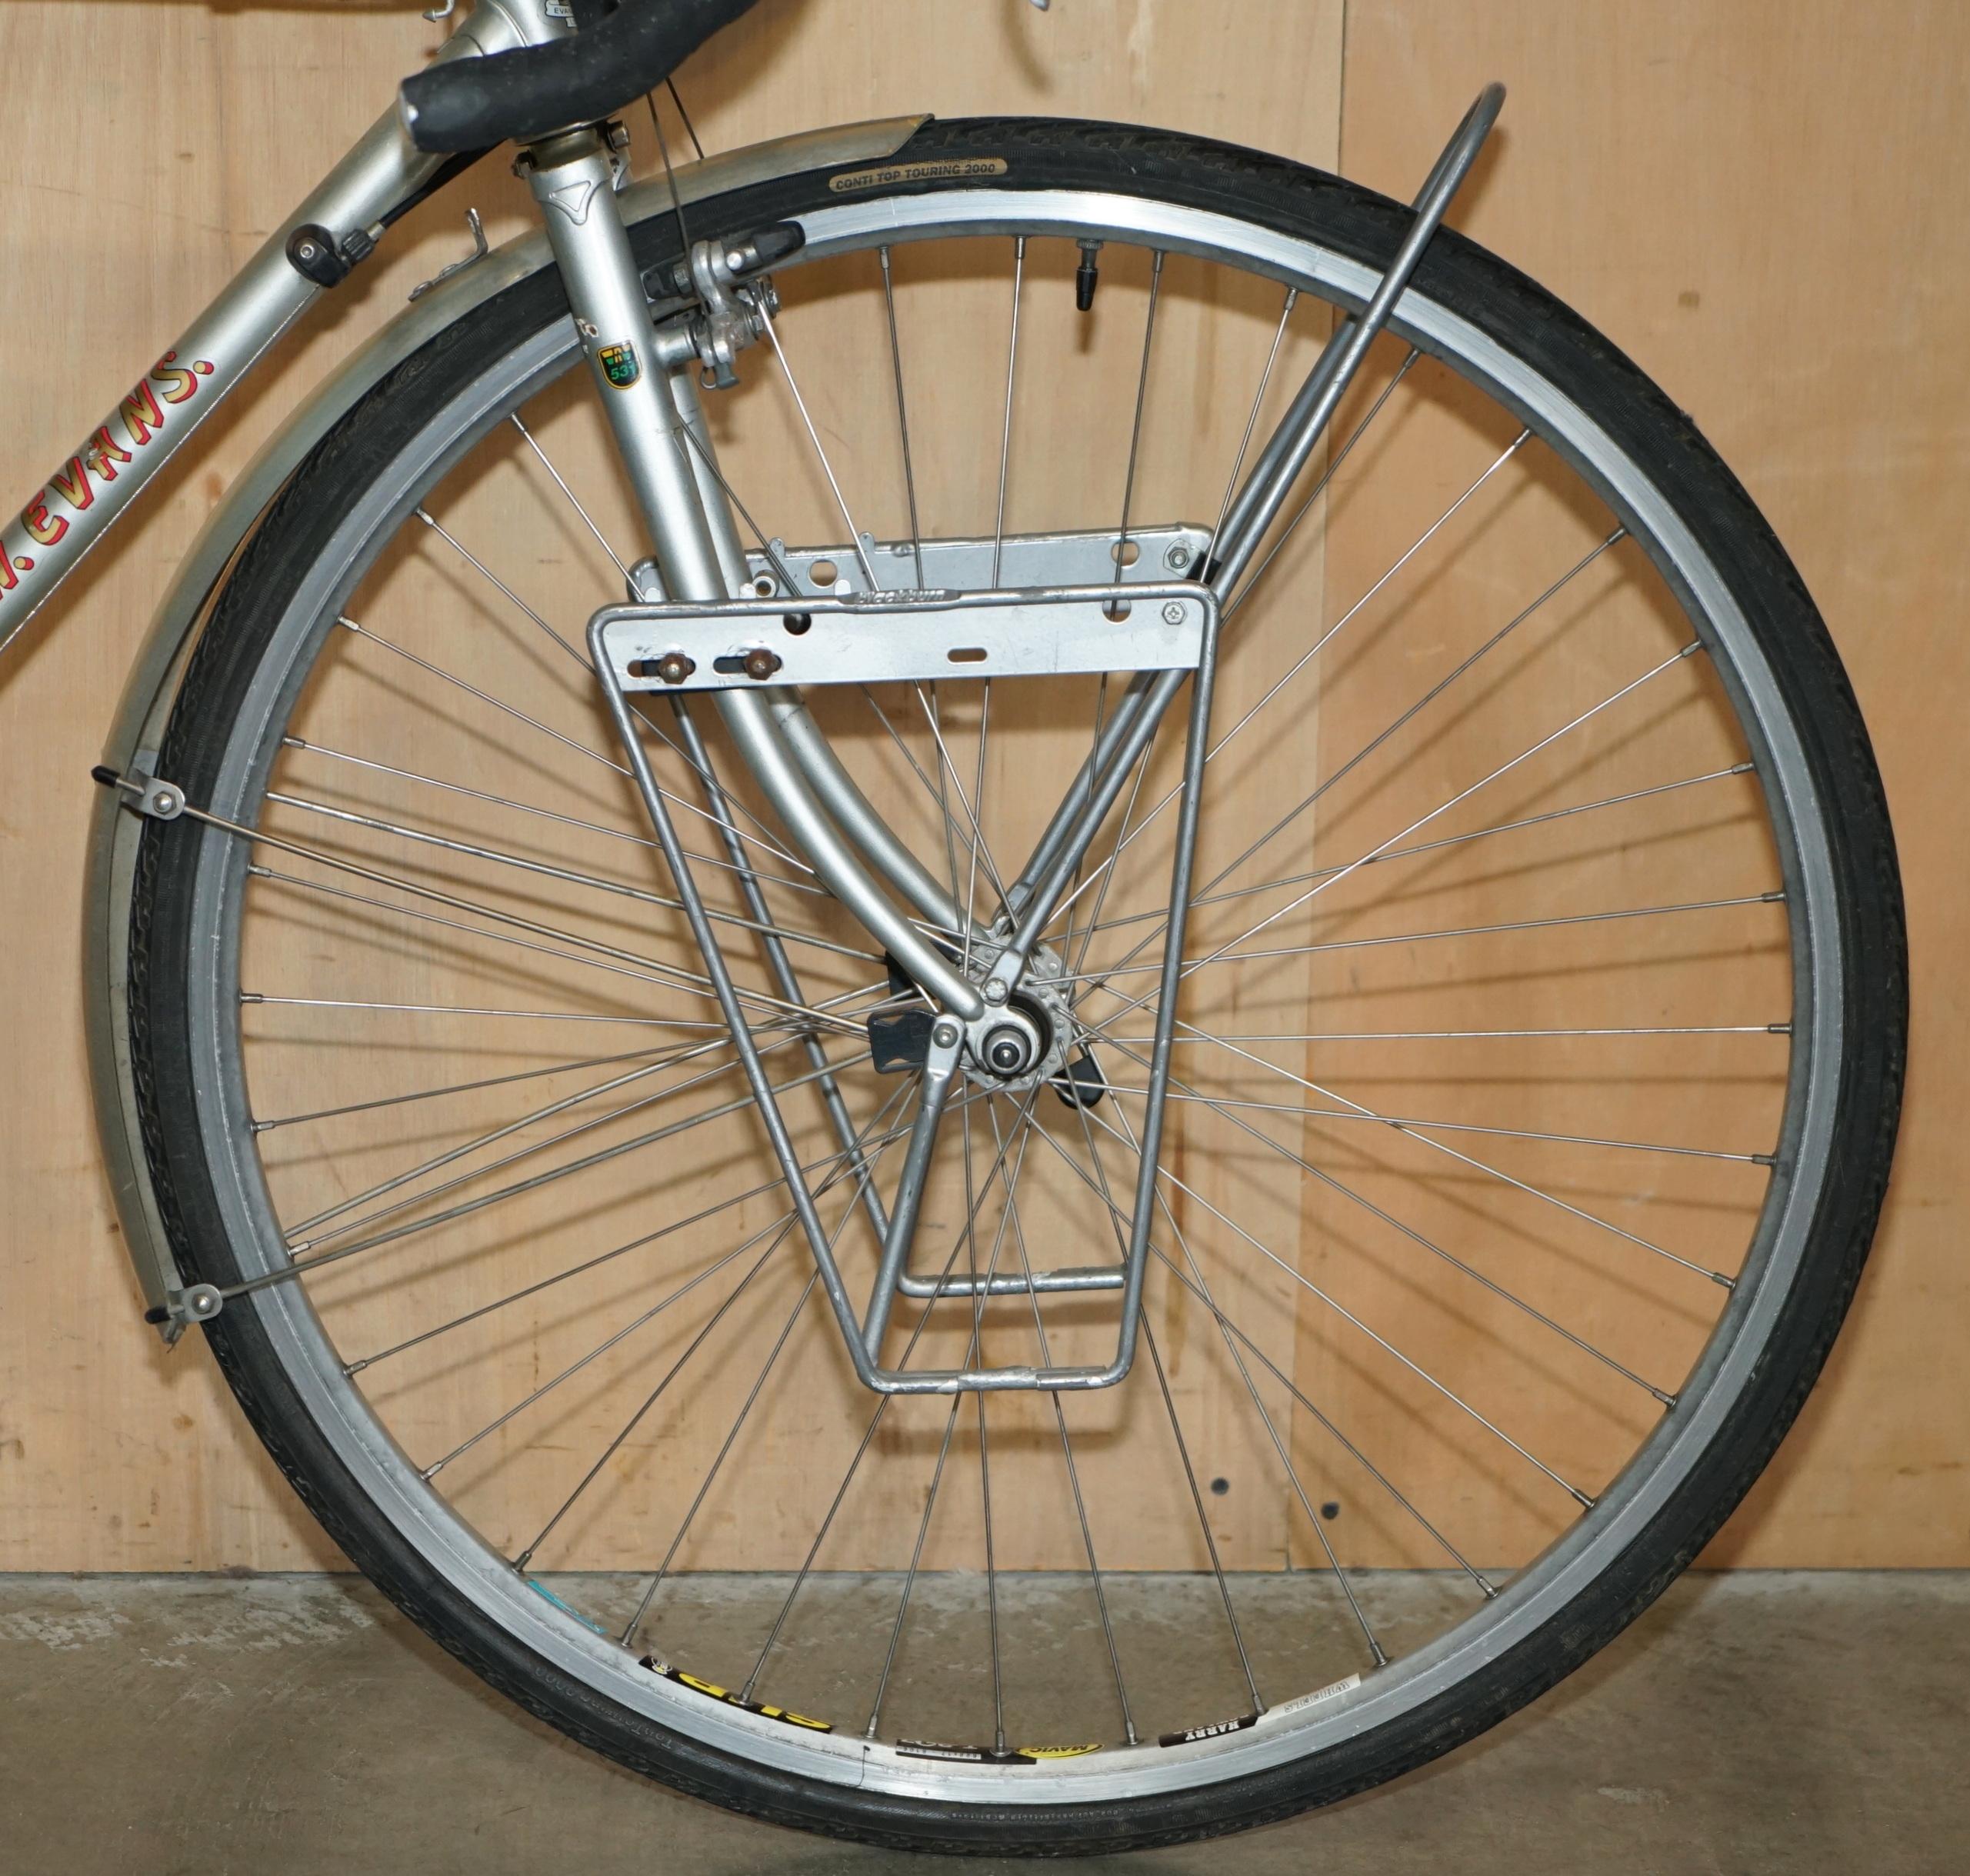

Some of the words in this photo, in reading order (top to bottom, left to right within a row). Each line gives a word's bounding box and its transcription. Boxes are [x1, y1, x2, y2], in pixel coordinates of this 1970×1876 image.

[835, 175, 873, 191] CONTI
[877, 172, 901, 182] TOP
[905, 165, 961, 178] TOURING
[964, 163, 996, 174] 2000
[1185, 1721, 1240, 1741] HARRY
